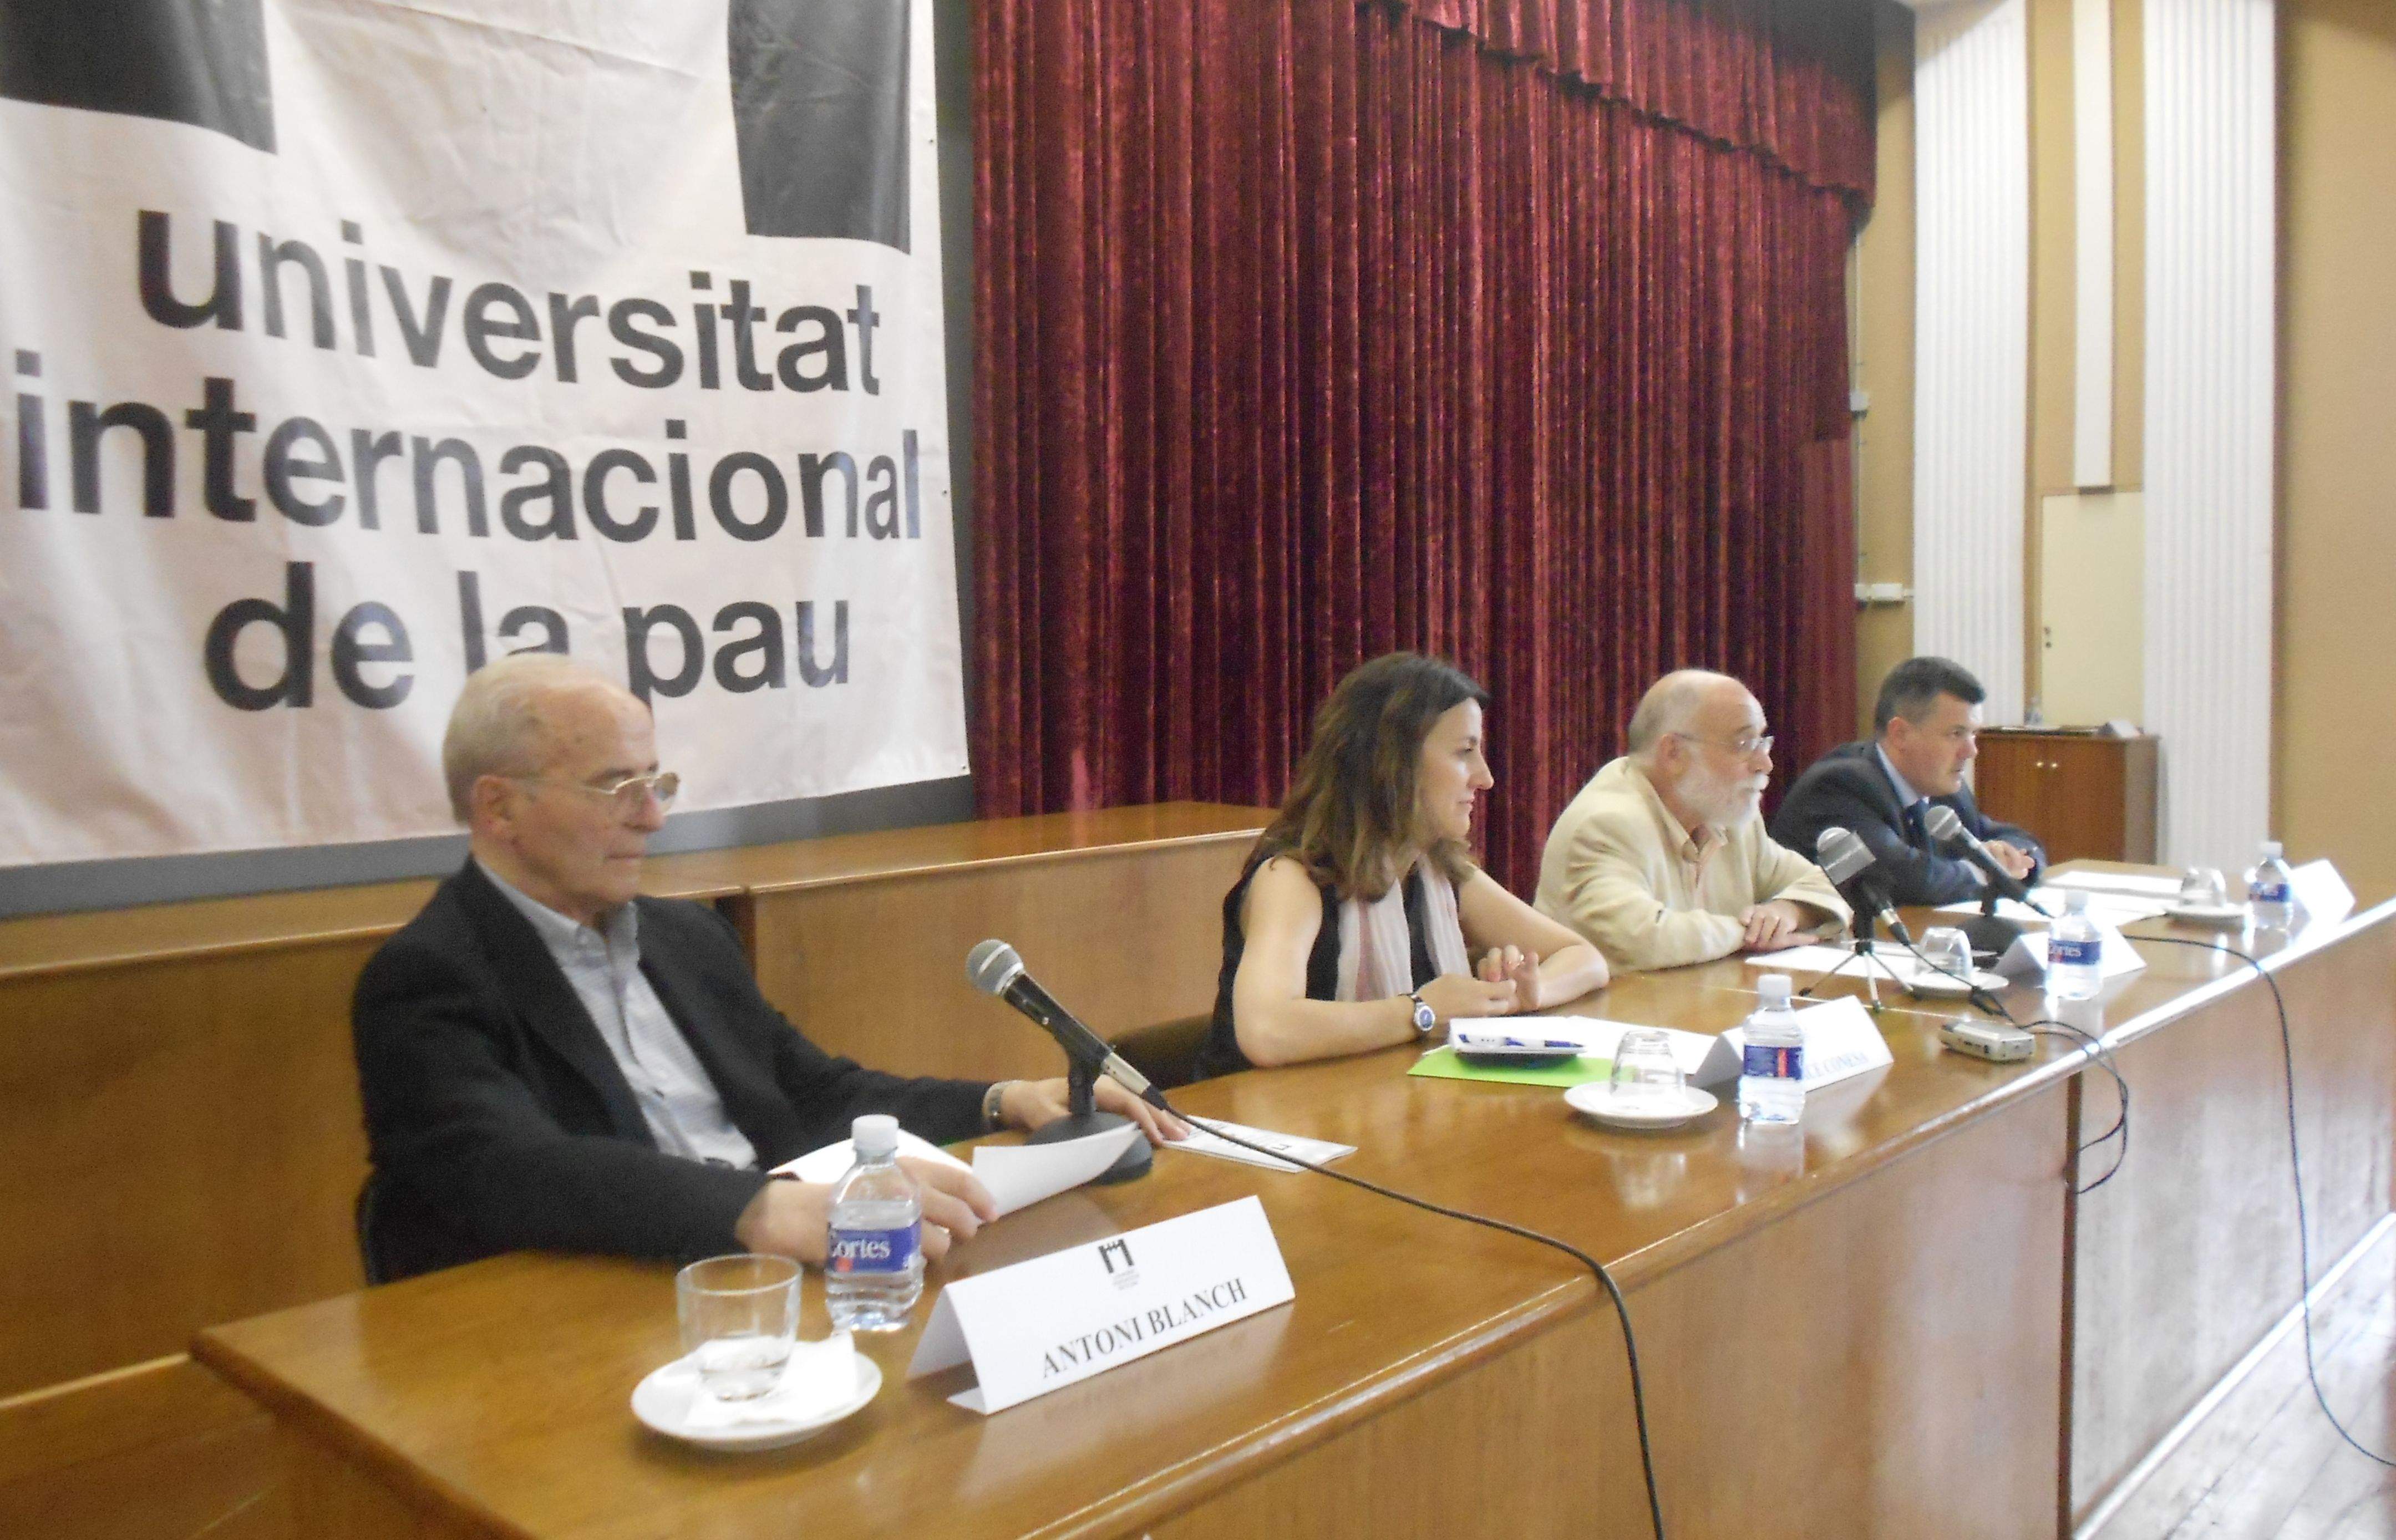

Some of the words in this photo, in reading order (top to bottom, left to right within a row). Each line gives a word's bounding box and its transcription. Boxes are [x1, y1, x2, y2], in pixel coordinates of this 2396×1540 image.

[137, 209, 880, 395] universitat
[15, 349, 922, 542] internacional
[204, 561, 415, 711] de
[622, 598, 850, 713] pau
[1041, 1318, 1144, 1380] ANTONI
[1150, 1277, 1249, 1336] BLANCH
